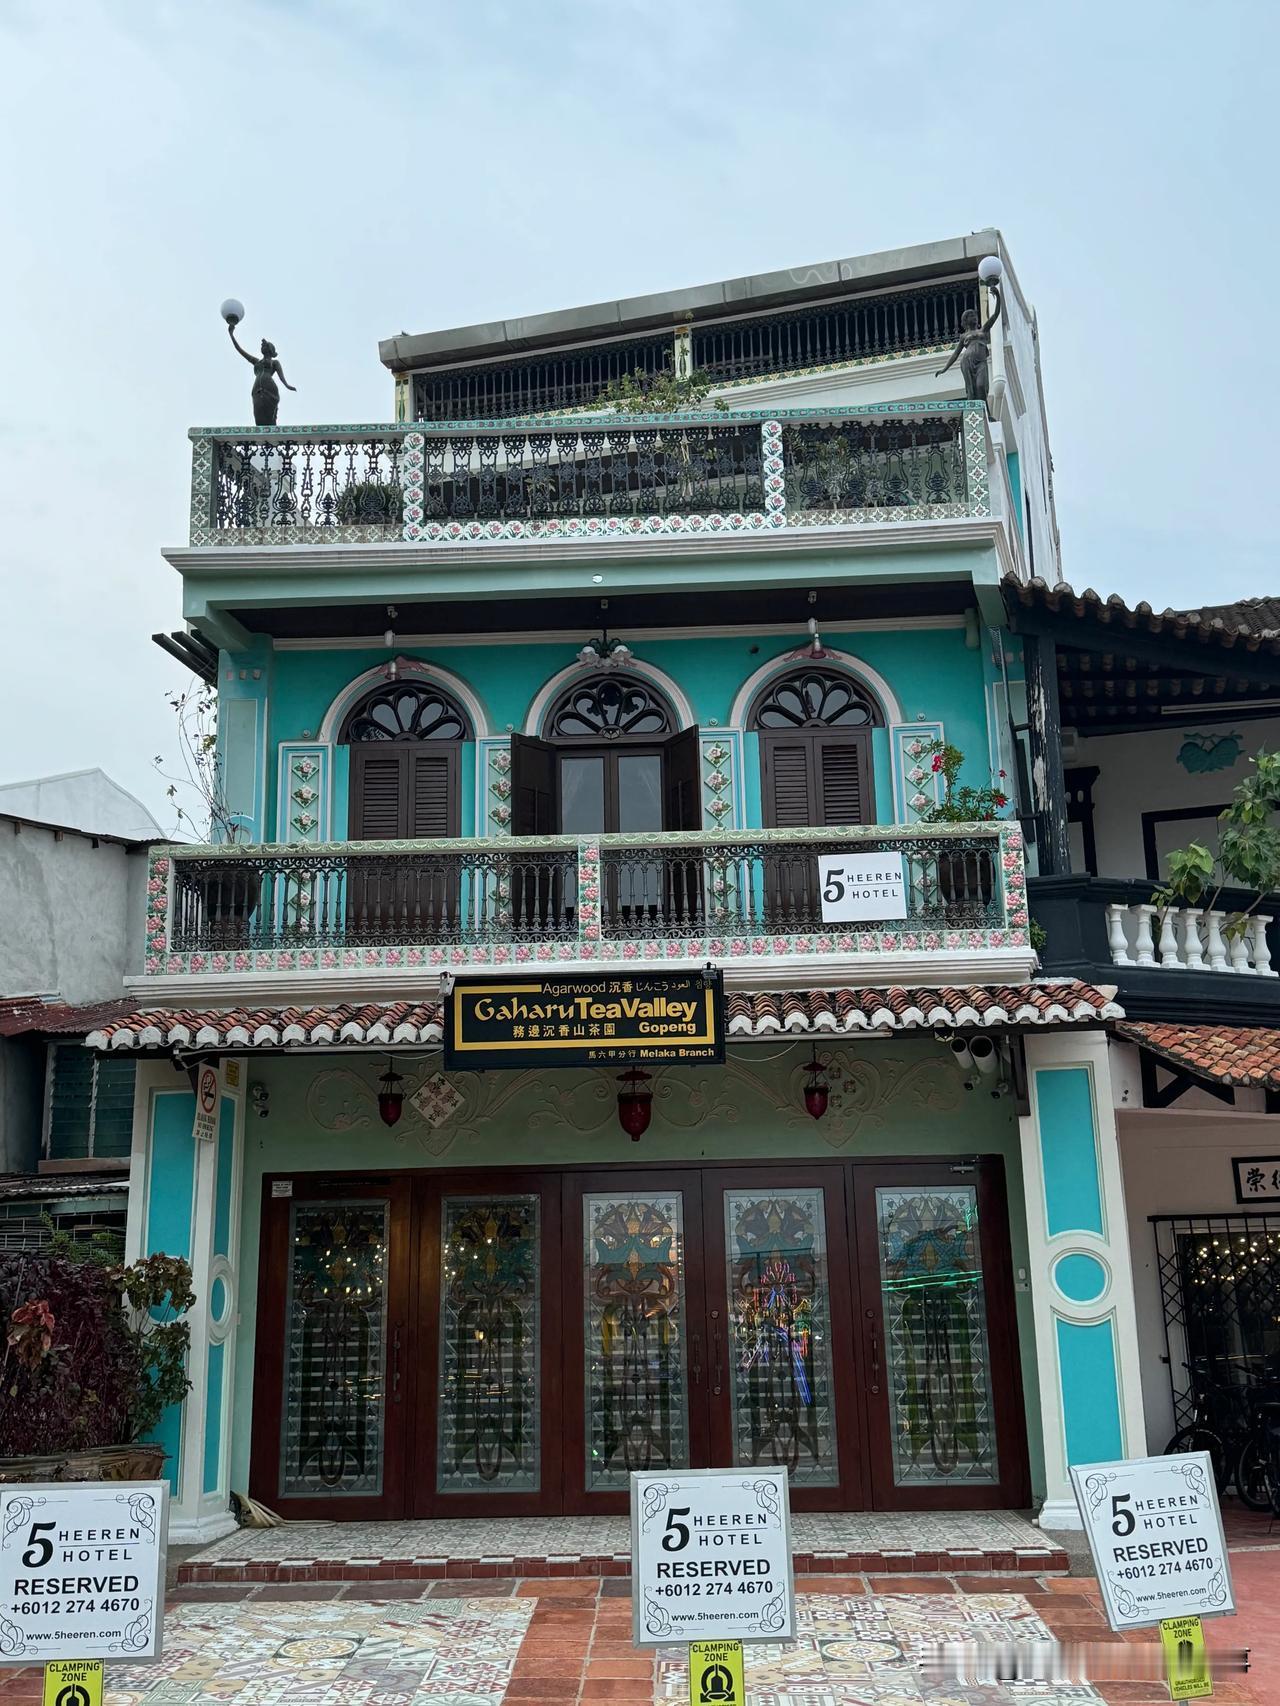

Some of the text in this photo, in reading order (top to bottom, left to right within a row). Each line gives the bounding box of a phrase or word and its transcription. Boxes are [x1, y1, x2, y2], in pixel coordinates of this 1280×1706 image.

[823, 869, 901, 903] 5 HEEREN
[852, 889, 899, 899] HOTEL
[543, 981, 605, 996] Agarwood
[636, 981, 669, 992] じんこう
[638, 1022, 697, 1035] Gopeng
[640, 1048, 714, 1058] Melaka Branch
[1112, 1493, 1198, 1537] 5 HEEREN
[1143, 1513, 1197, 1529] HOTEL
[661, 1507, 767, 1551] 5 HEEREN
[22, 1521, 140, 1568] 5 HEEREN
[699, 1534, 762, 1546] HOTEL
[63, 1549, 133, 1562] HOTEL
[1113, 1537, 1208, 1563] RESERVED
[657, 1559, 771, 1578] RESERVED
[1117, 1557, 1213, 1580] +6012 274 4670
[14, 1575, 139, 1595] RESERVED
[655, 1581, 773, 1597] +6012 274 4670
[1136, 1587, 1206, 1602] www.5heeren.com
[11, 1598, 140, 1615] +6012 274 4670
[671, 1611, 759, 1621] www.5heeren.com
[1163, 1618, 1199, 1630] CLAMPING
[26, 1630, 121, 1641] www.5heeren.com
[1174, 1628, 1192, 1638] ZONE
[692, 1642, 739, 1653] CLAMPING
[704, 1652, 728, 1661] ZONE
[49, 1662, 100, 1673] CLAMPING
[61, 1673, 87, 1682] ZONE
